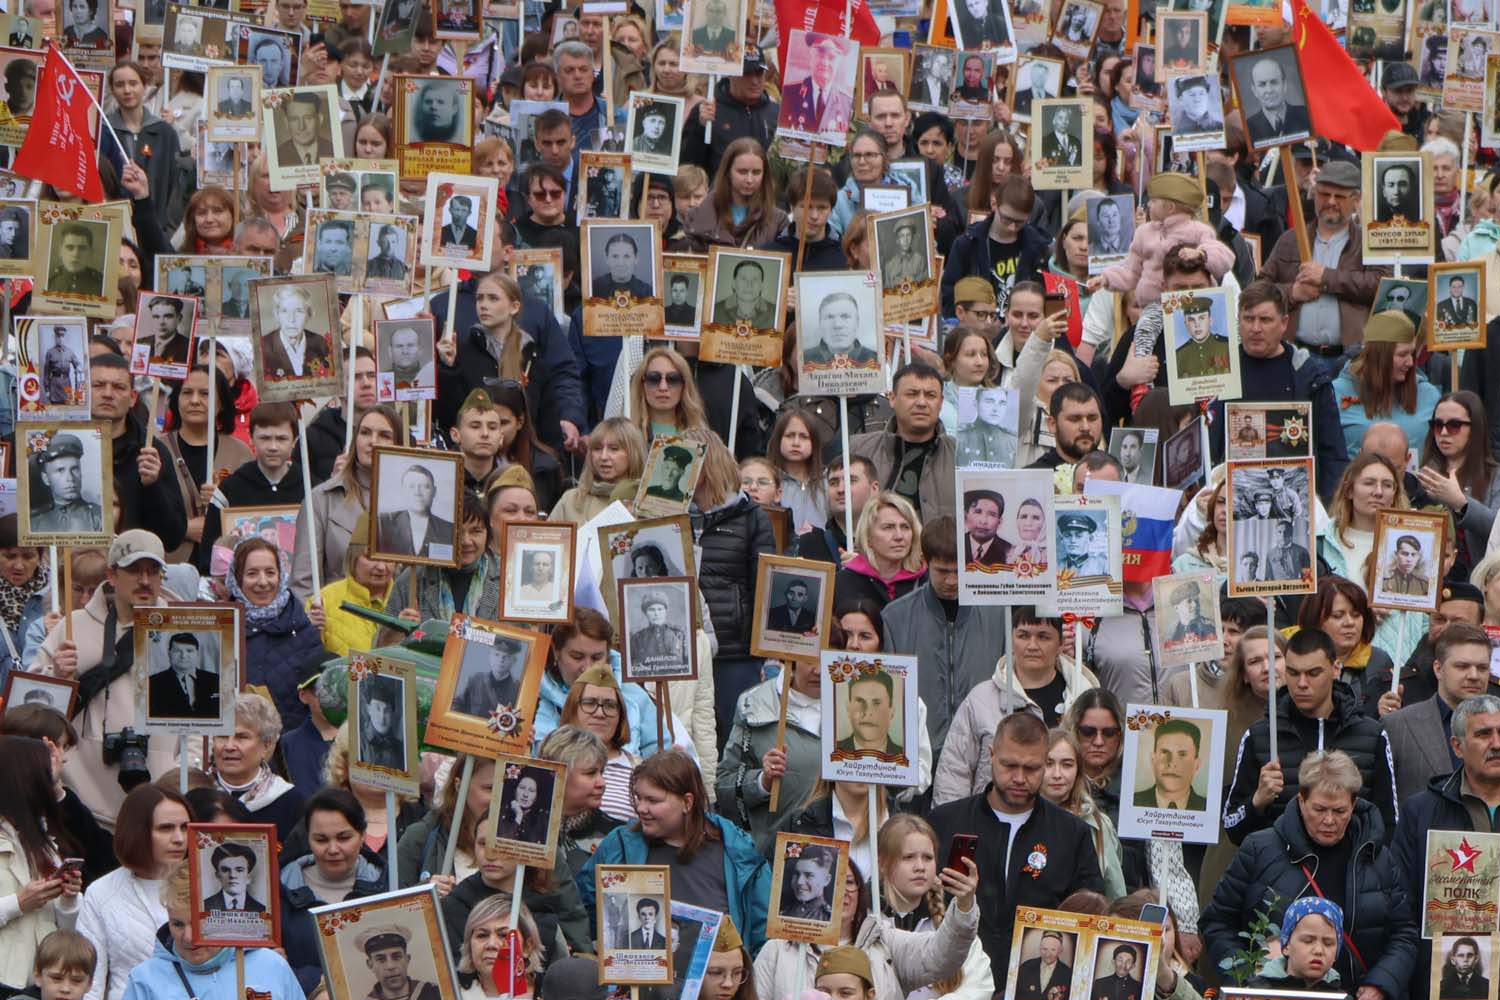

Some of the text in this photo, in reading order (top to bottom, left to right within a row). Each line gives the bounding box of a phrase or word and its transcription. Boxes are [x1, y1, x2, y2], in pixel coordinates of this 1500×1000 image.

[843, 761, 897, 771] Хайрутдинов
[1143, 809, 1196, 820] Хайрутдинов
[1443, 886, 1480, 899] ПОЛК
